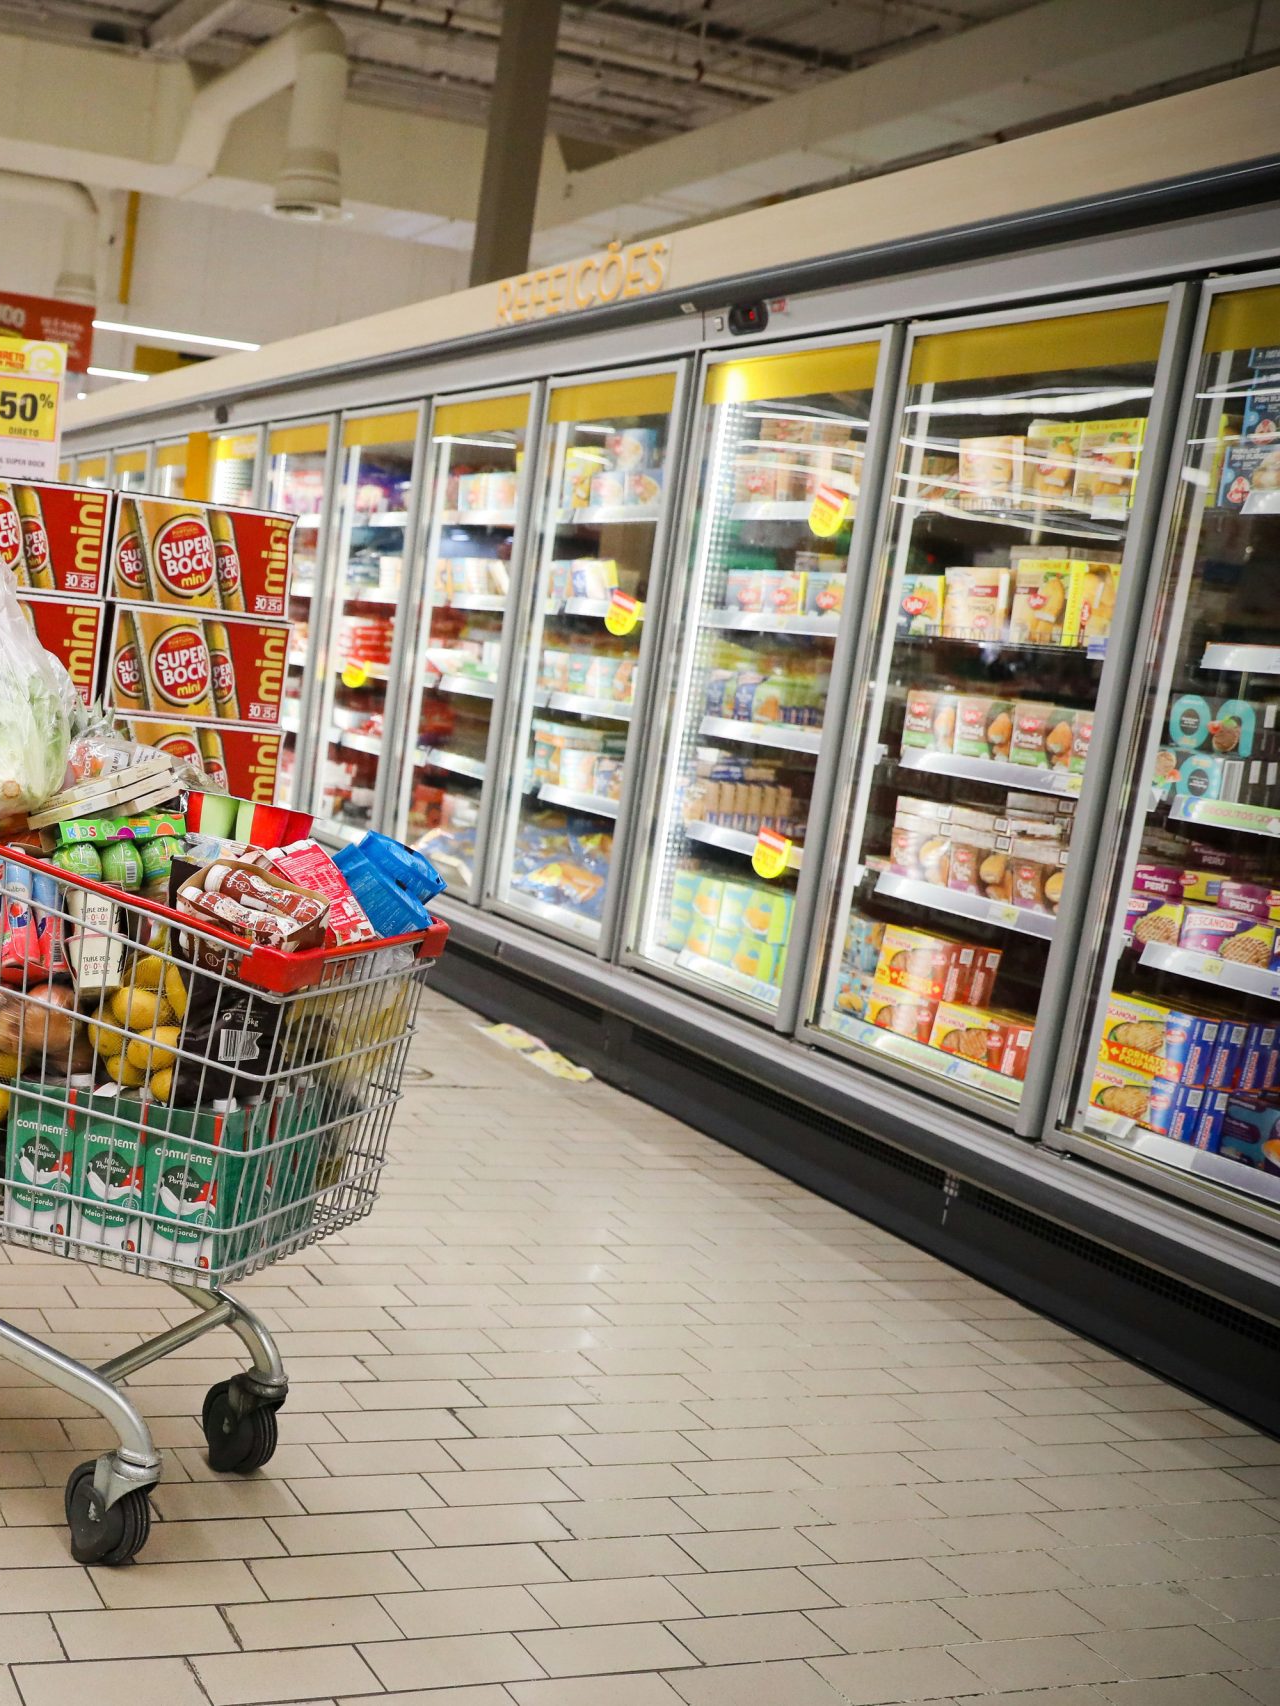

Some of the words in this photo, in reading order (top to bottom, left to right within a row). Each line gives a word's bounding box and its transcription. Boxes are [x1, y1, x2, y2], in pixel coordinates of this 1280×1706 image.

[0, 390, 54, 422] 50%
[8, 426, 39, 437] DIRETO
[70, 492, 105, 572] mini
[160, 535, 211, 560] SUPER
[260, 518, 294, 595] mini
[165, 552, 213, 577] BOCK
[65, 573, 79, 587] 30
[180, 571, 206, 588] mini
[254, 596, 267, 610] 30
[63, 605, 97, 684] mini
[157, 645, 208, 670] SUPER
[255, 627, 286, 703] mini
[162, 663, 209, 686] BOCK
[176, 681, 201, 697] mini
[248, 703, 260, 718] 30
[248, 734, 282, 806] mini
[66, 822, 97, 838] KIDS
[1144, 880, 1169, 892] PERU
[1229, 900, 1255, 912] PERU
[1188, 914, 1235, 930] PESCANOVA
[1122, 1046, 1168, 1068] FORMATO
